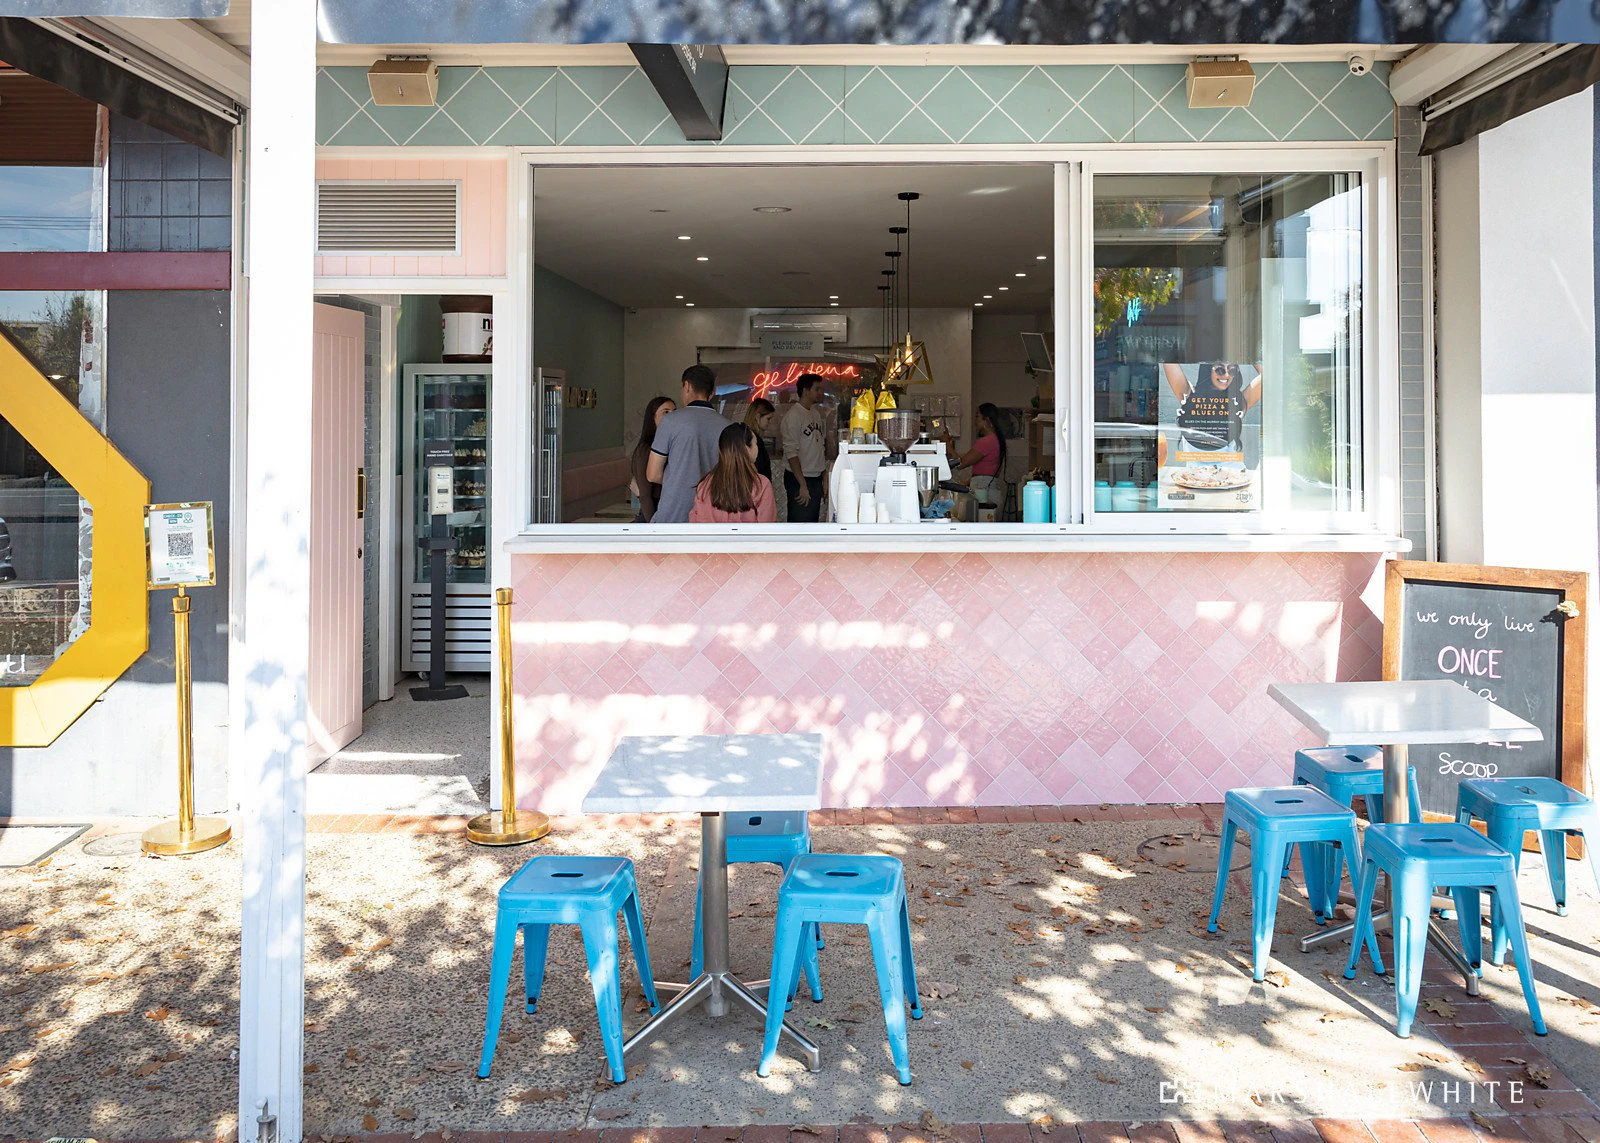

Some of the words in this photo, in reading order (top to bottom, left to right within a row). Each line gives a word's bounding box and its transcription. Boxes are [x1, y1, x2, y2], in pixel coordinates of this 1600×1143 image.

[1416, 611, 1439, 624] we
[1448, 611, 1493, 640] only
[1504, 615, 1535, 633] live
[1437, 645, 1504, 679] ONCE
[1438, 751, 1499, 778] Scoop
